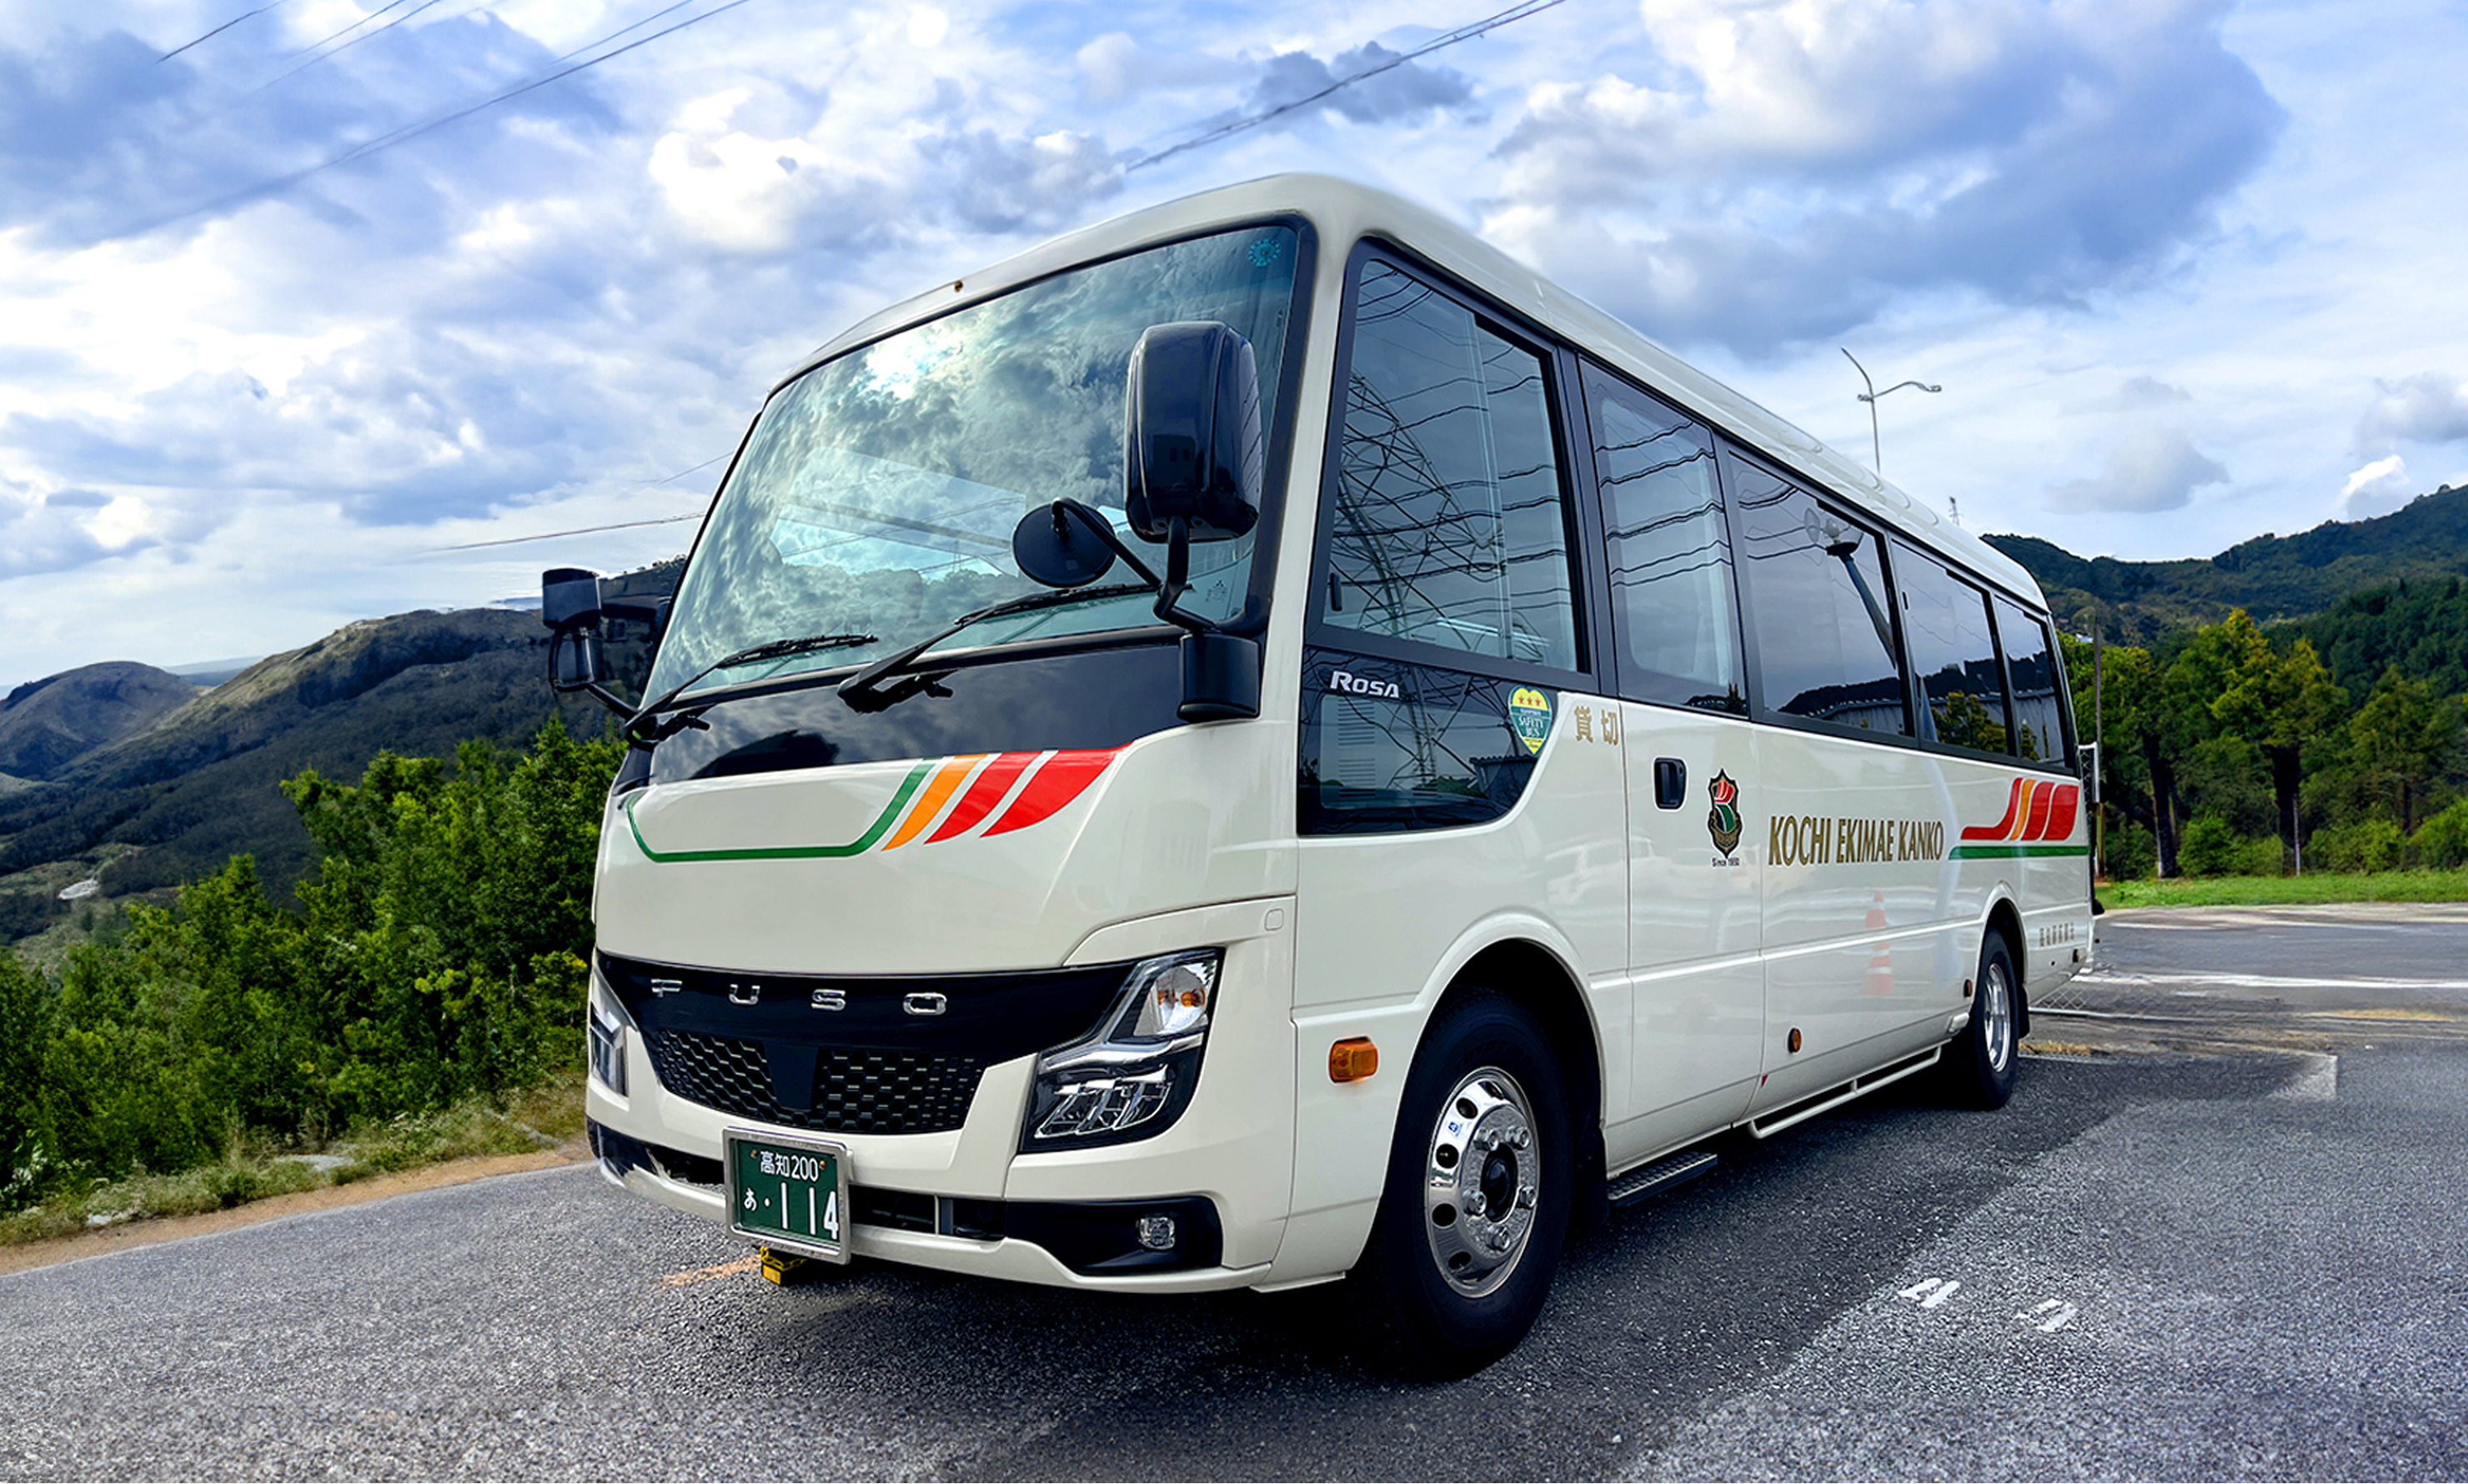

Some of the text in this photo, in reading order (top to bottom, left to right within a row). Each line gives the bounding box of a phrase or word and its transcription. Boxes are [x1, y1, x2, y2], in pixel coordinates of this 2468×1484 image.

[1330, 670, 1399, 699] ROSA
[1518, 715, 1544, 729] SAFETY
[1573, 704, 1619, 746] 貸切
[1768, 815, 1944, 867] KOCHI EKIMAE KANKO
[650, 978, 947, 1015] FUSO
